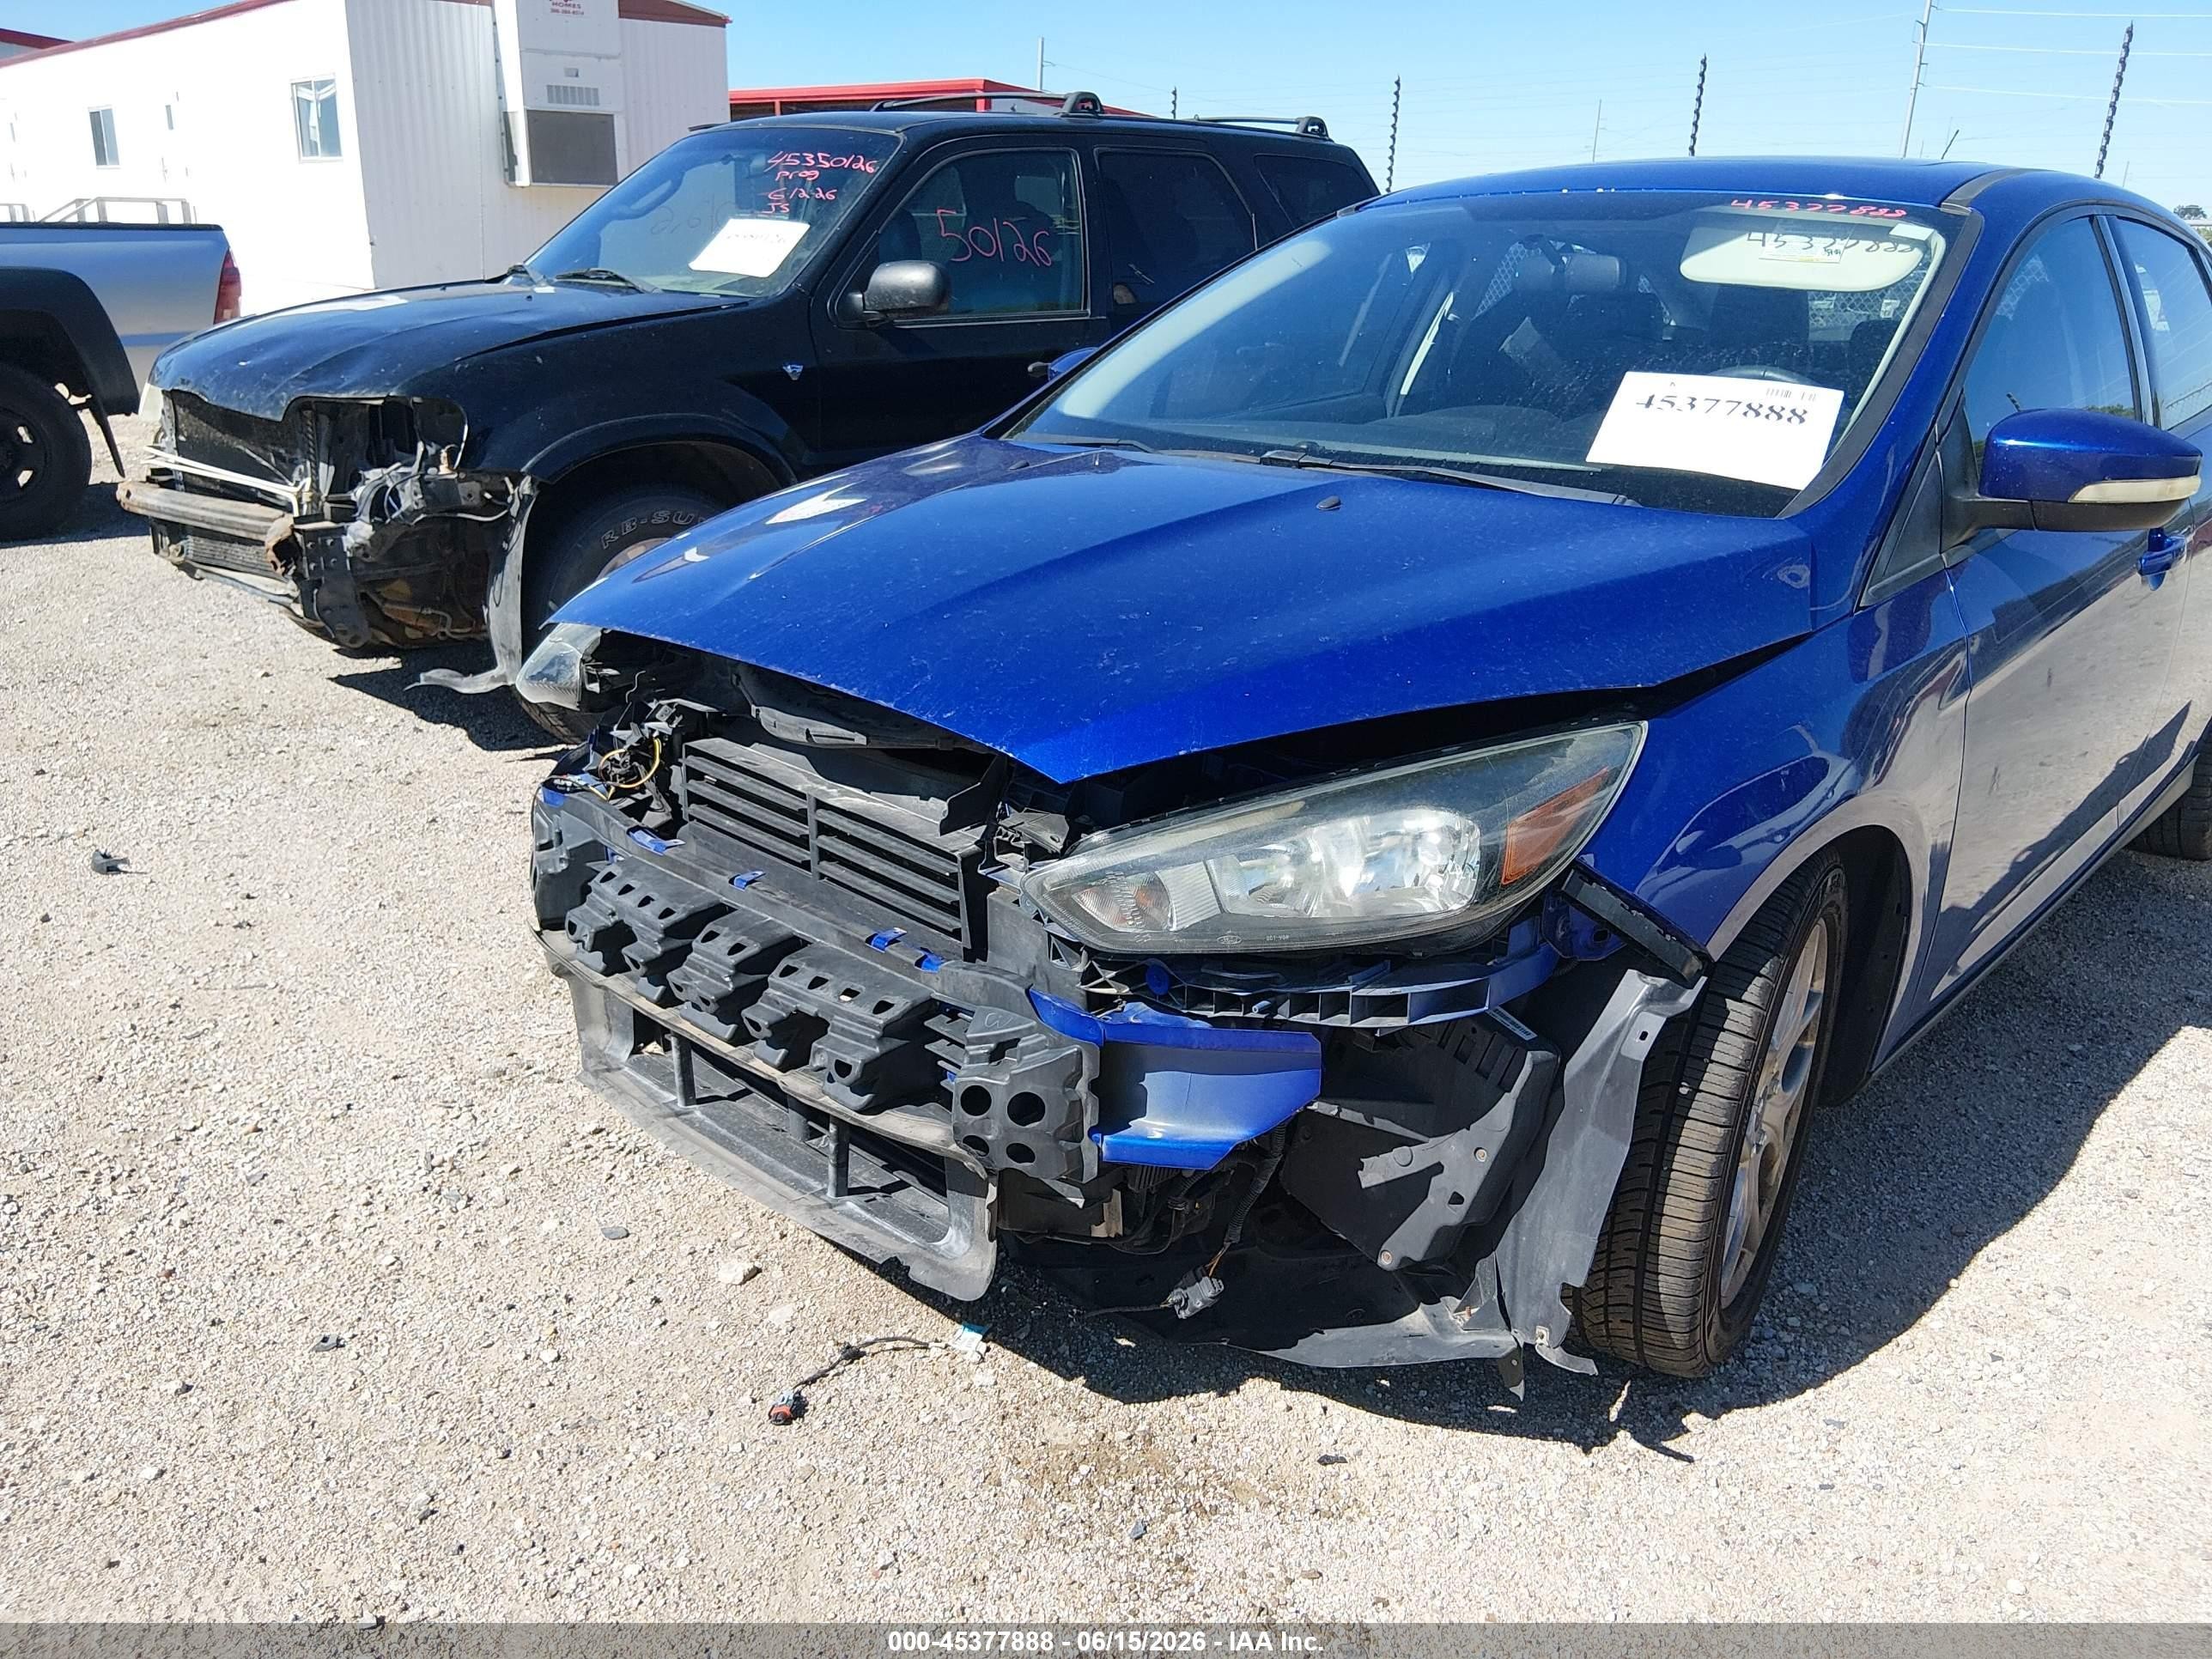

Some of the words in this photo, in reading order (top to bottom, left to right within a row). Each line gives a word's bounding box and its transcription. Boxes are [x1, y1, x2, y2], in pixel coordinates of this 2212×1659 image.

[763, 151, 879, 173] 45350126
[1731, 199, 1907, 217] 45377888
[937, 209, 1052, 266] 50126
[1636, 394, 1808, 424] 45377888
